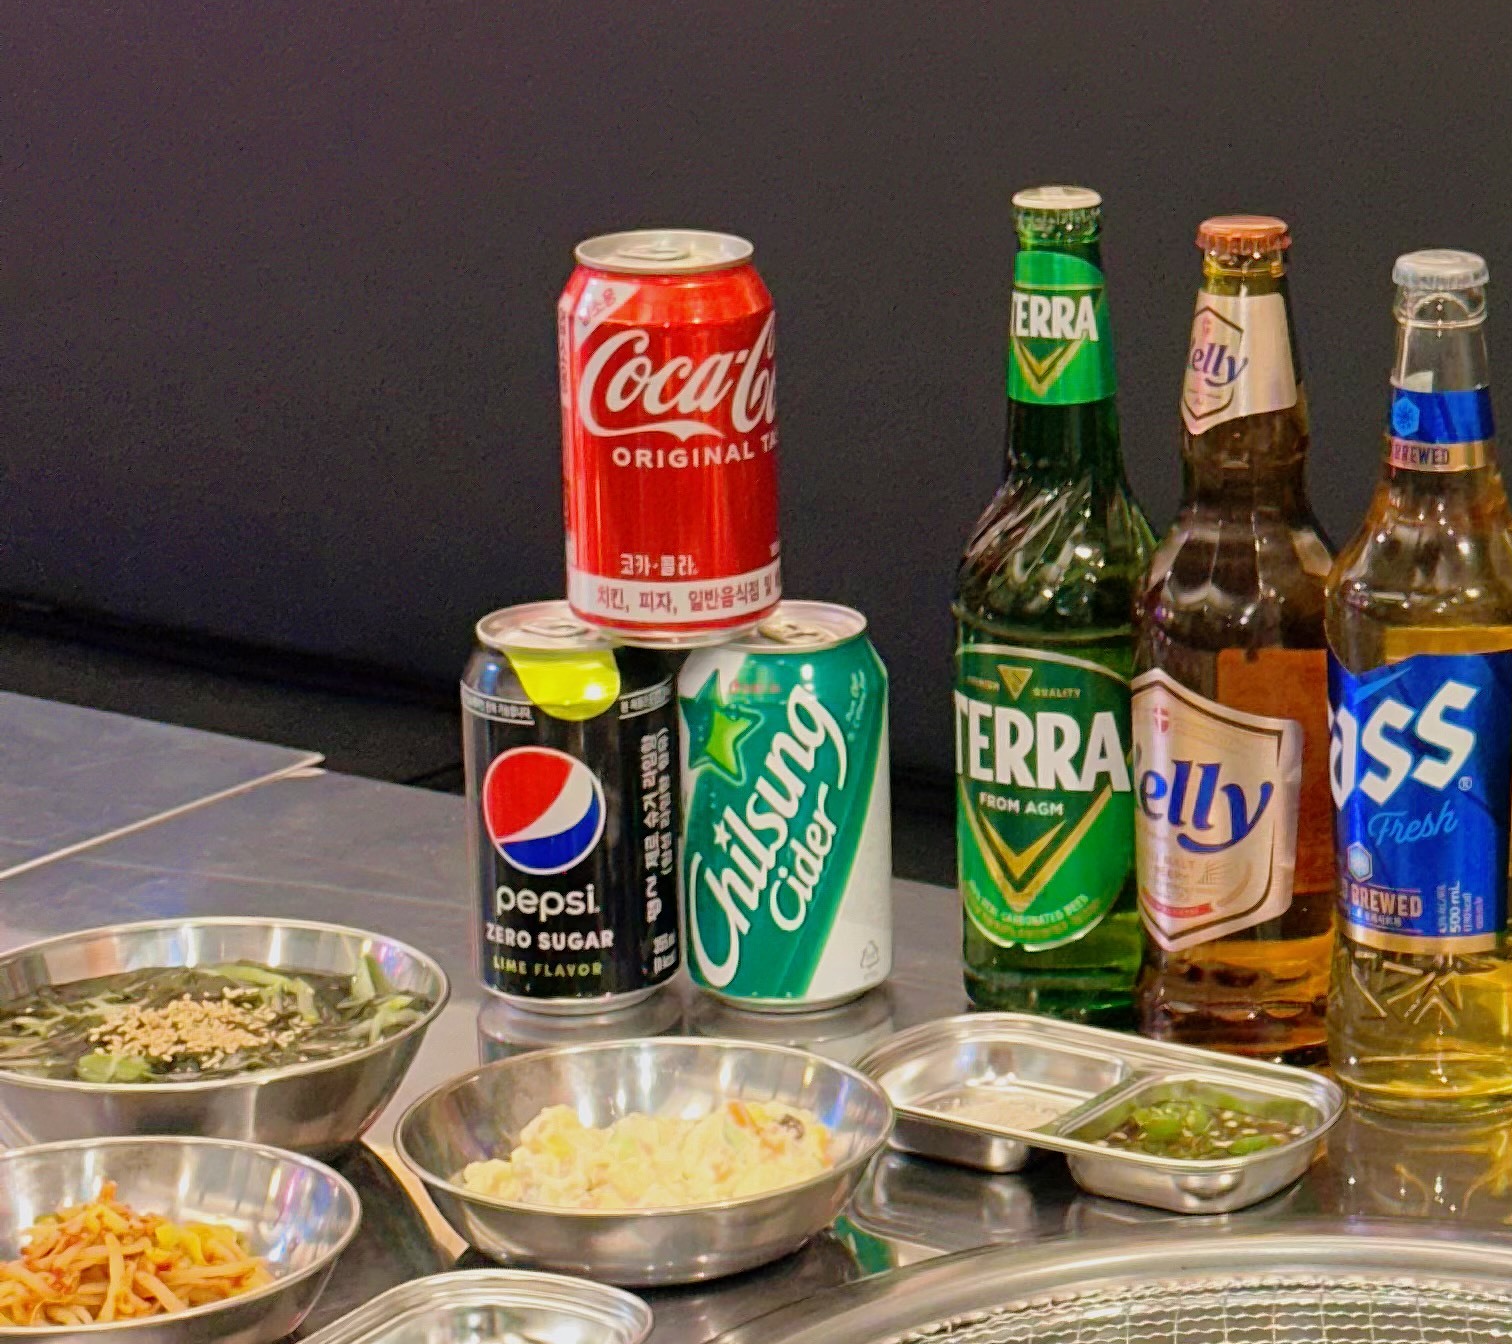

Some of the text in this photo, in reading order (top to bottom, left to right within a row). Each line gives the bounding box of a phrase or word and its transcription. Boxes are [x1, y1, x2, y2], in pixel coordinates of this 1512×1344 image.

[1187, 342, 1249, 388] elly
[612, 440, 755, 469] ORIGINAL
[639, 590, 678, 615] 피자,
[688, 579, 760, 613] 일반음식점
[1327, 679, 1480, 812] ASS
[979, 791, 1064, 816] FROM AGM
[1132, 742, 1274, 854] elly
[690, 684, 847, 987] Chilsung
[1368, 799, 1459, 846] Fresh
[769, 782, 837, 931] Cider
[497, 883, 595, 923] pepsi
[1351, 883, 1424, 918] BREWED
[1449, 903, 1462, 934] 500
[485, 921, 614, 952] ZERO SUGAR
[493, 954, 603, 978] LIME FLAVOR
